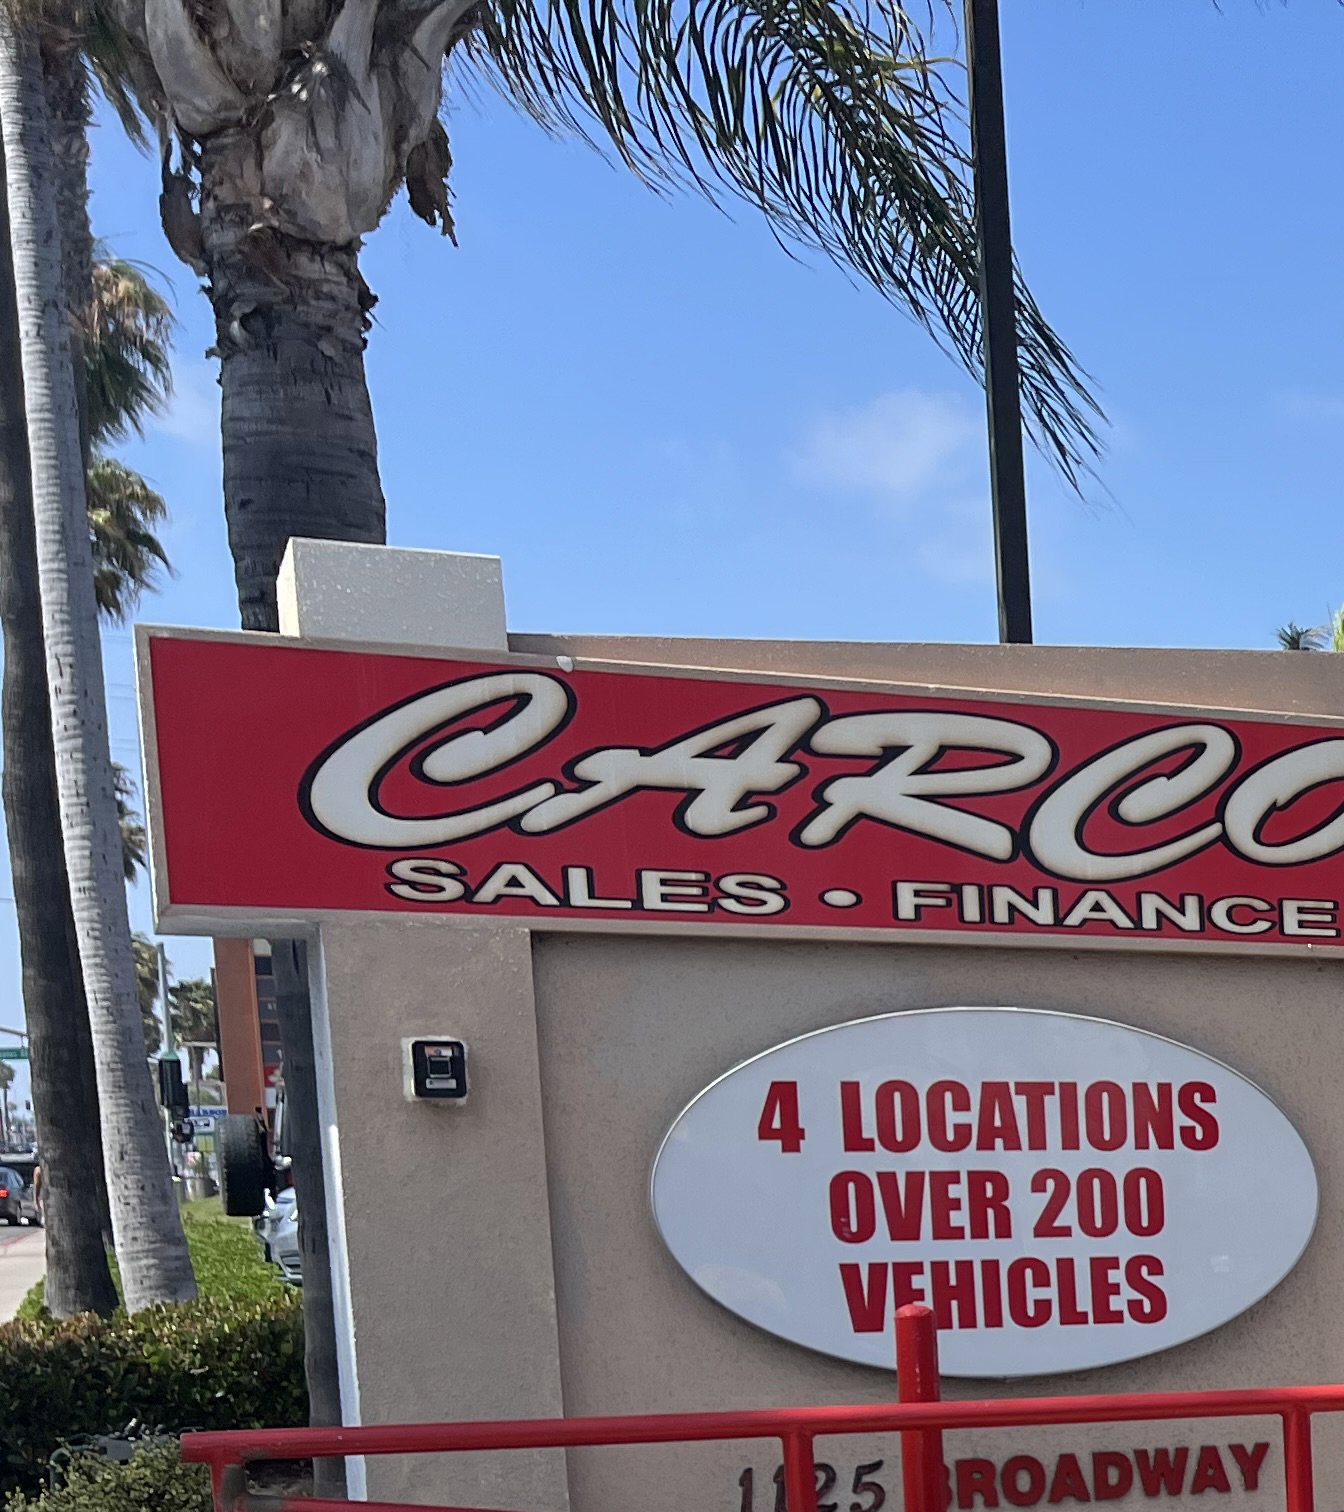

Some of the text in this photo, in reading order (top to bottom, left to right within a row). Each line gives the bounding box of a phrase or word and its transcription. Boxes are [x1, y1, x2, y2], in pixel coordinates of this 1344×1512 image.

[384, 856, 1341, 938] SALES FINANCE
[757, 1079, 1221, 1154] 4 LOCATIONS
[828, 1166, 1165, 1244] OVER 200
[839, 1255, 1169, 1334] VEHICLES
[945, 1442, 1270, 1509] ROADWAY
